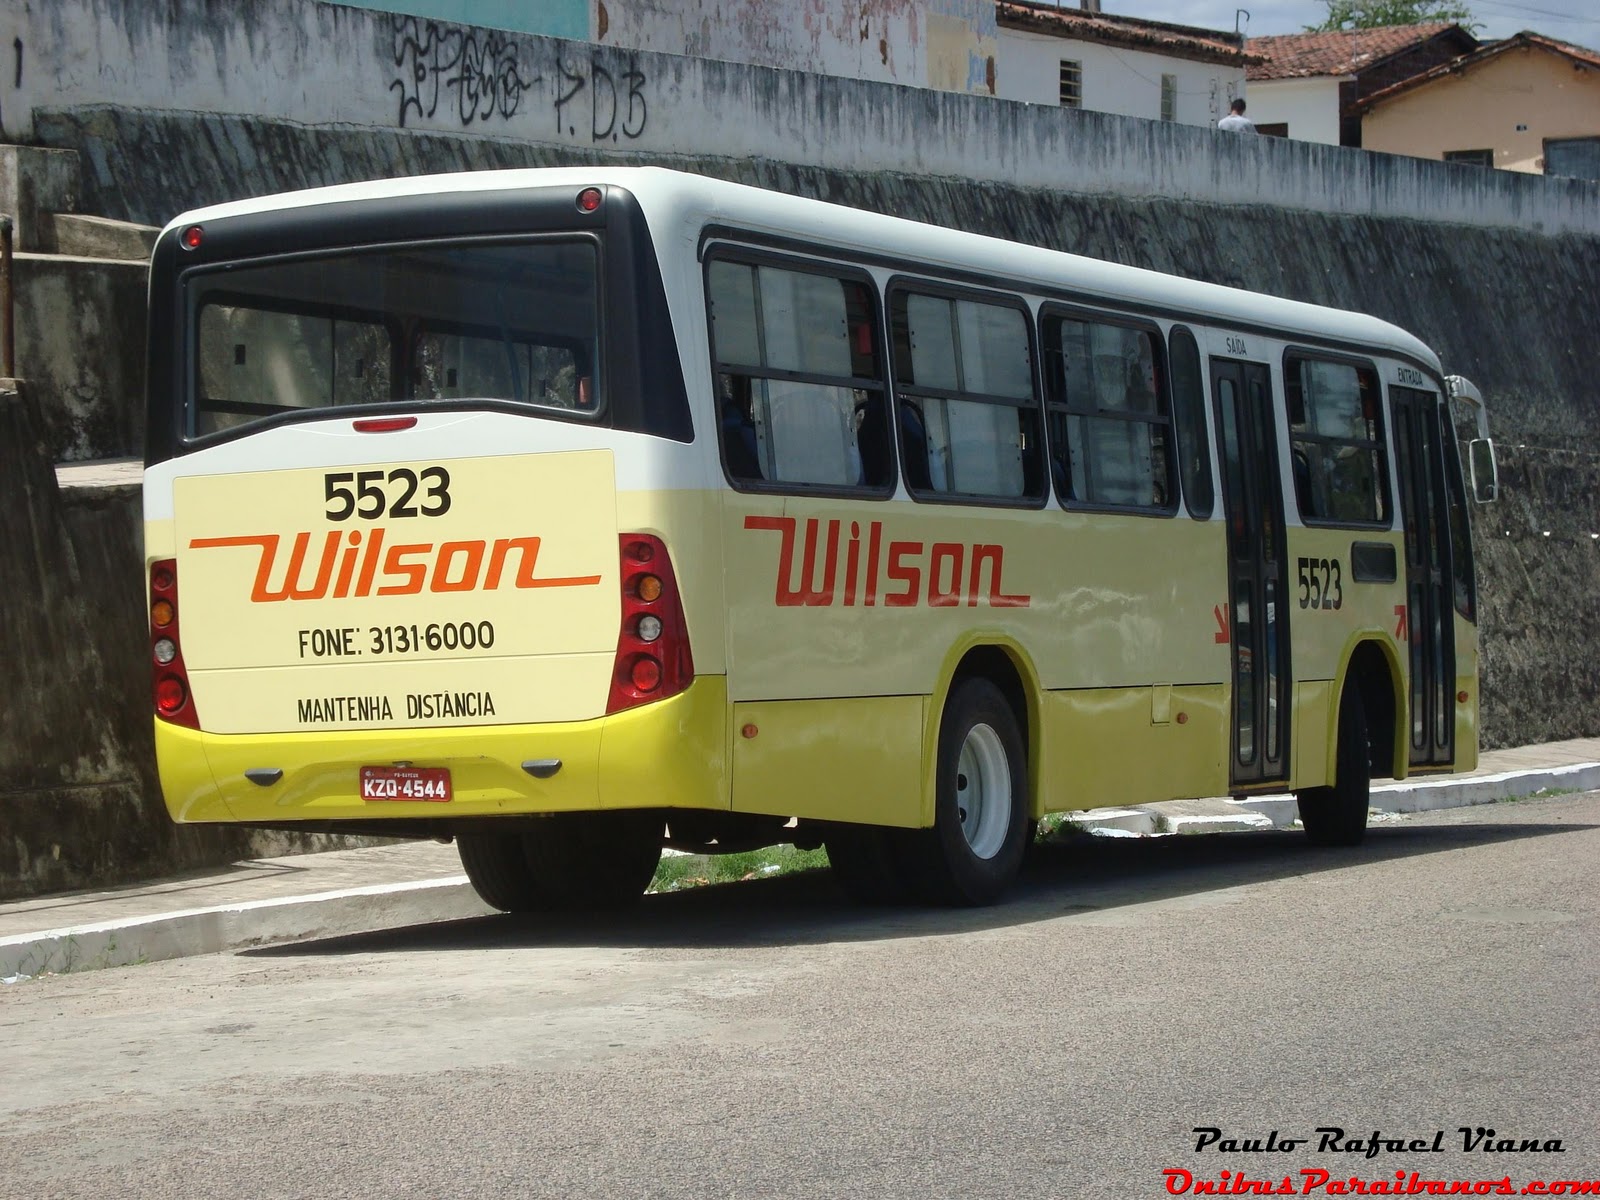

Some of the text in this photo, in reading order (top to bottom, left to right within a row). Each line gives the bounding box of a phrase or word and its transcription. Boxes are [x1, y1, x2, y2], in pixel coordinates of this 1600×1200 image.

[1226, 335, 1247, 356] SAÍDA
[1398, 367, 1423, 387] ENTRADA
[324, 466, 451, 522] 5523
[189, 528, 602, 603] Wilson
[744, 515, 1031, 608] Wilson
[1298, 556, 1343, 611] 5523
[298, 627, 362, 658] FONE:
[298, 690, 496, 723] MANTENHA DISTÂNCIA
